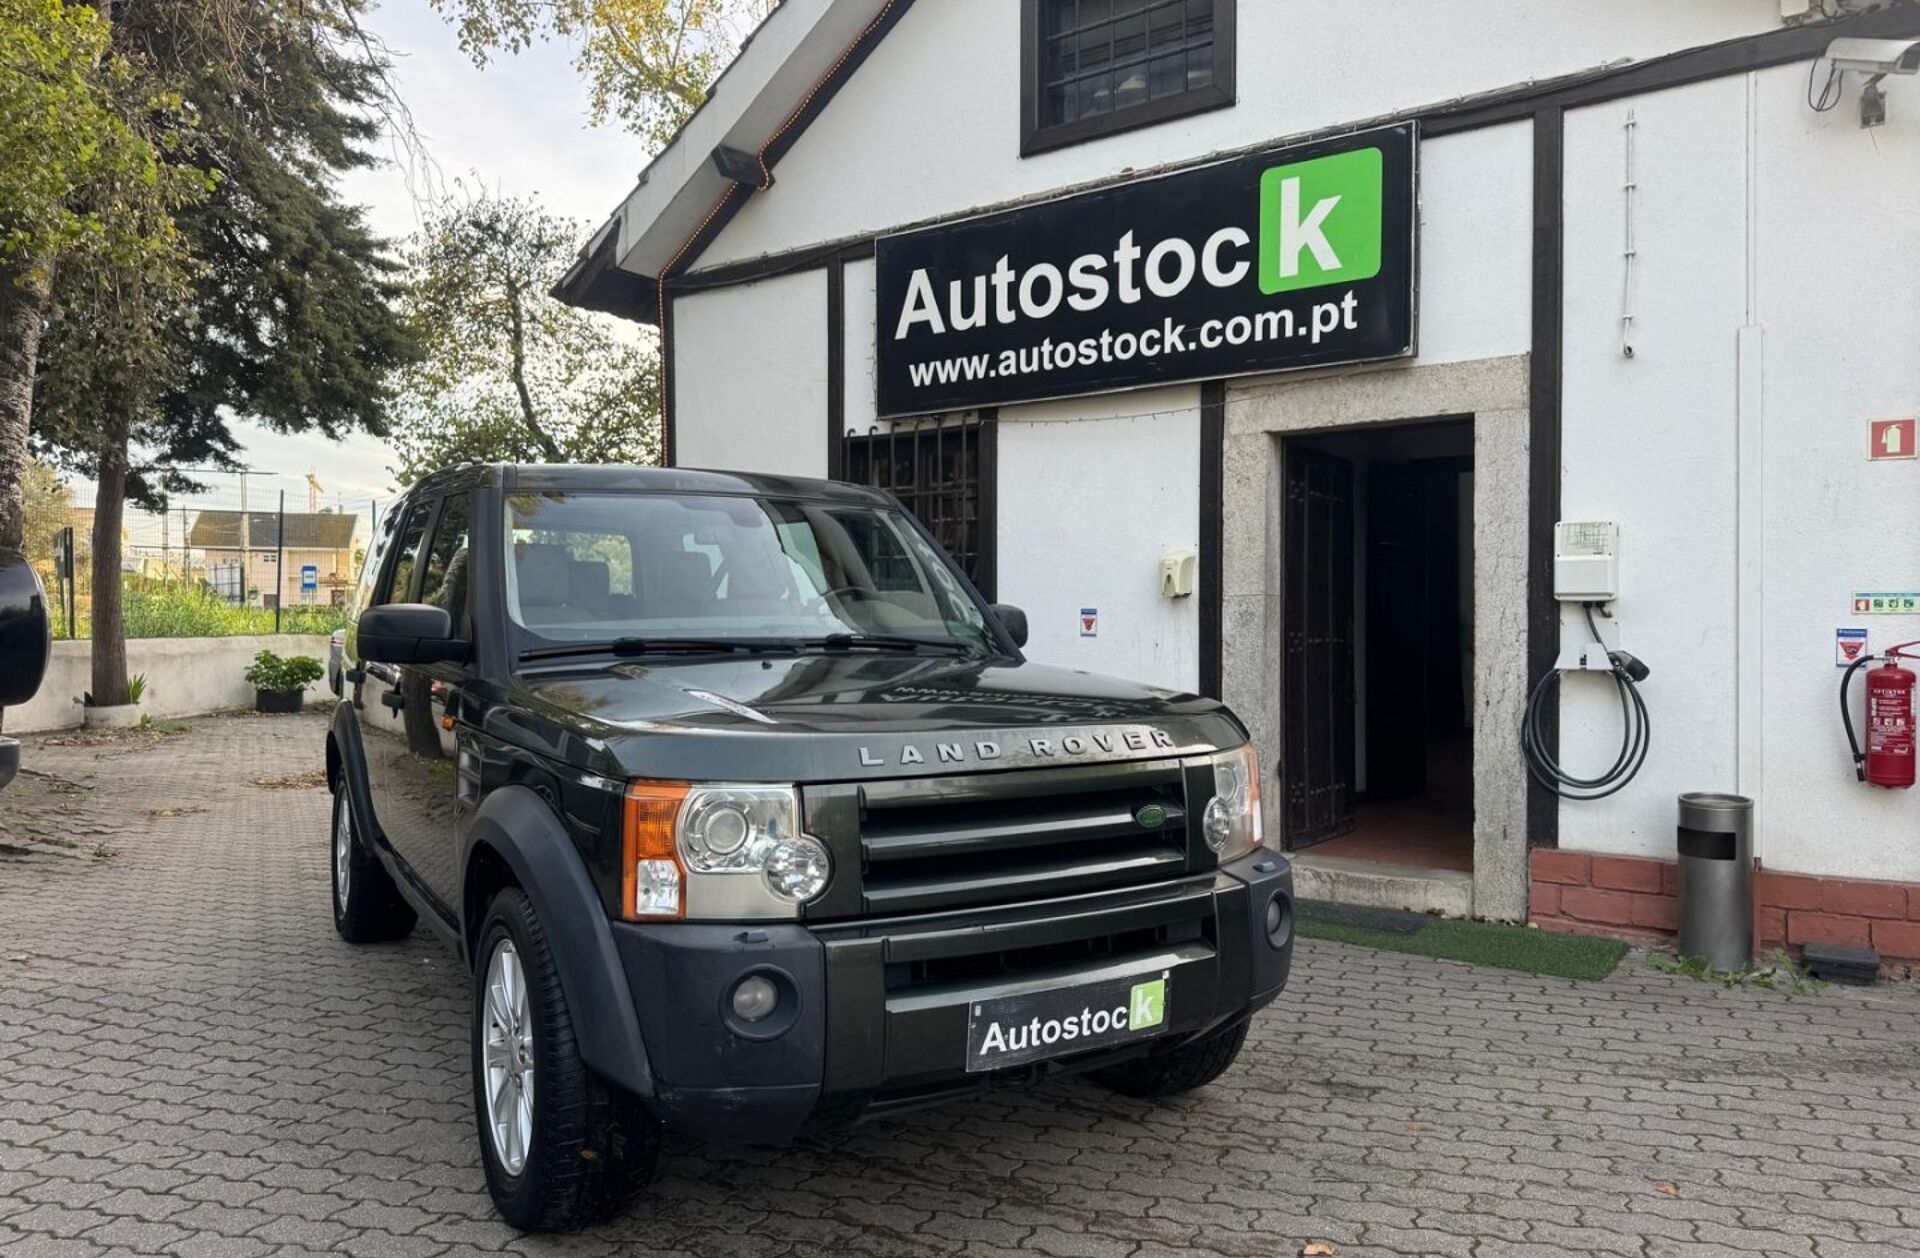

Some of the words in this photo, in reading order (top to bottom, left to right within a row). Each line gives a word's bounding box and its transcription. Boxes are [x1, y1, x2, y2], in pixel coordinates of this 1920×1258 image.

[894, 176, 1343, 340] Autostock
[908, 290, 1358, 387] www.autostock.com.pt
[859, 741, 1002, 767] LAND
[1028, 728, 1173, 758] ROVER
[979, 988, 1154, 1056] Autostock
